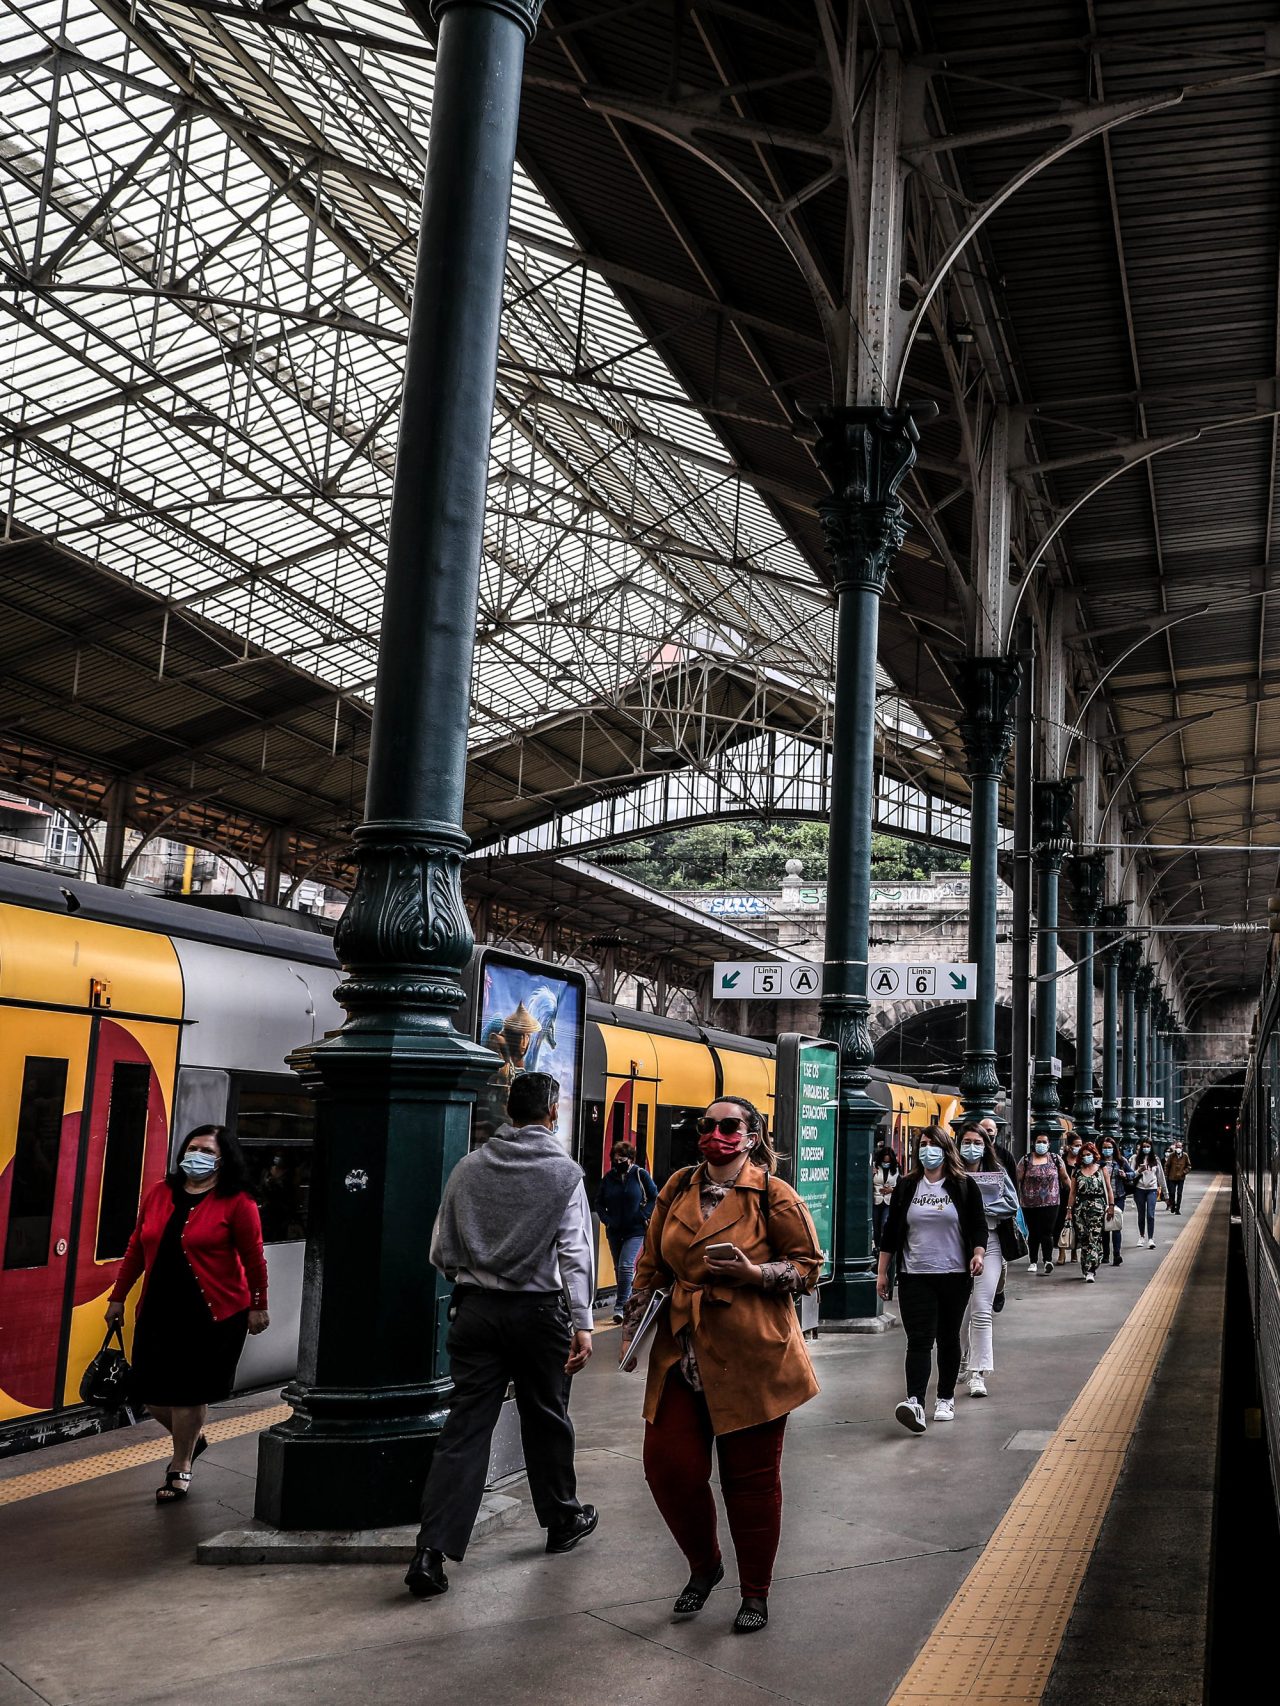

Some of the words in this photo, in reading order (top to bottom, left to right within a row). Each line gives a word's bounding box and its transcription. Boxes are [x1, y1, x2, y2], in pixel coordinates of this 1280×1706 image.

[762, 976, 774, 992] 5
[796, 973, 813, 989] A
[877, 974, 893, 990] A
[916, 976, 927, 993] 6
[823, 1086, 830, 1101] DE
[800, 1167, 809, 1182] SER
